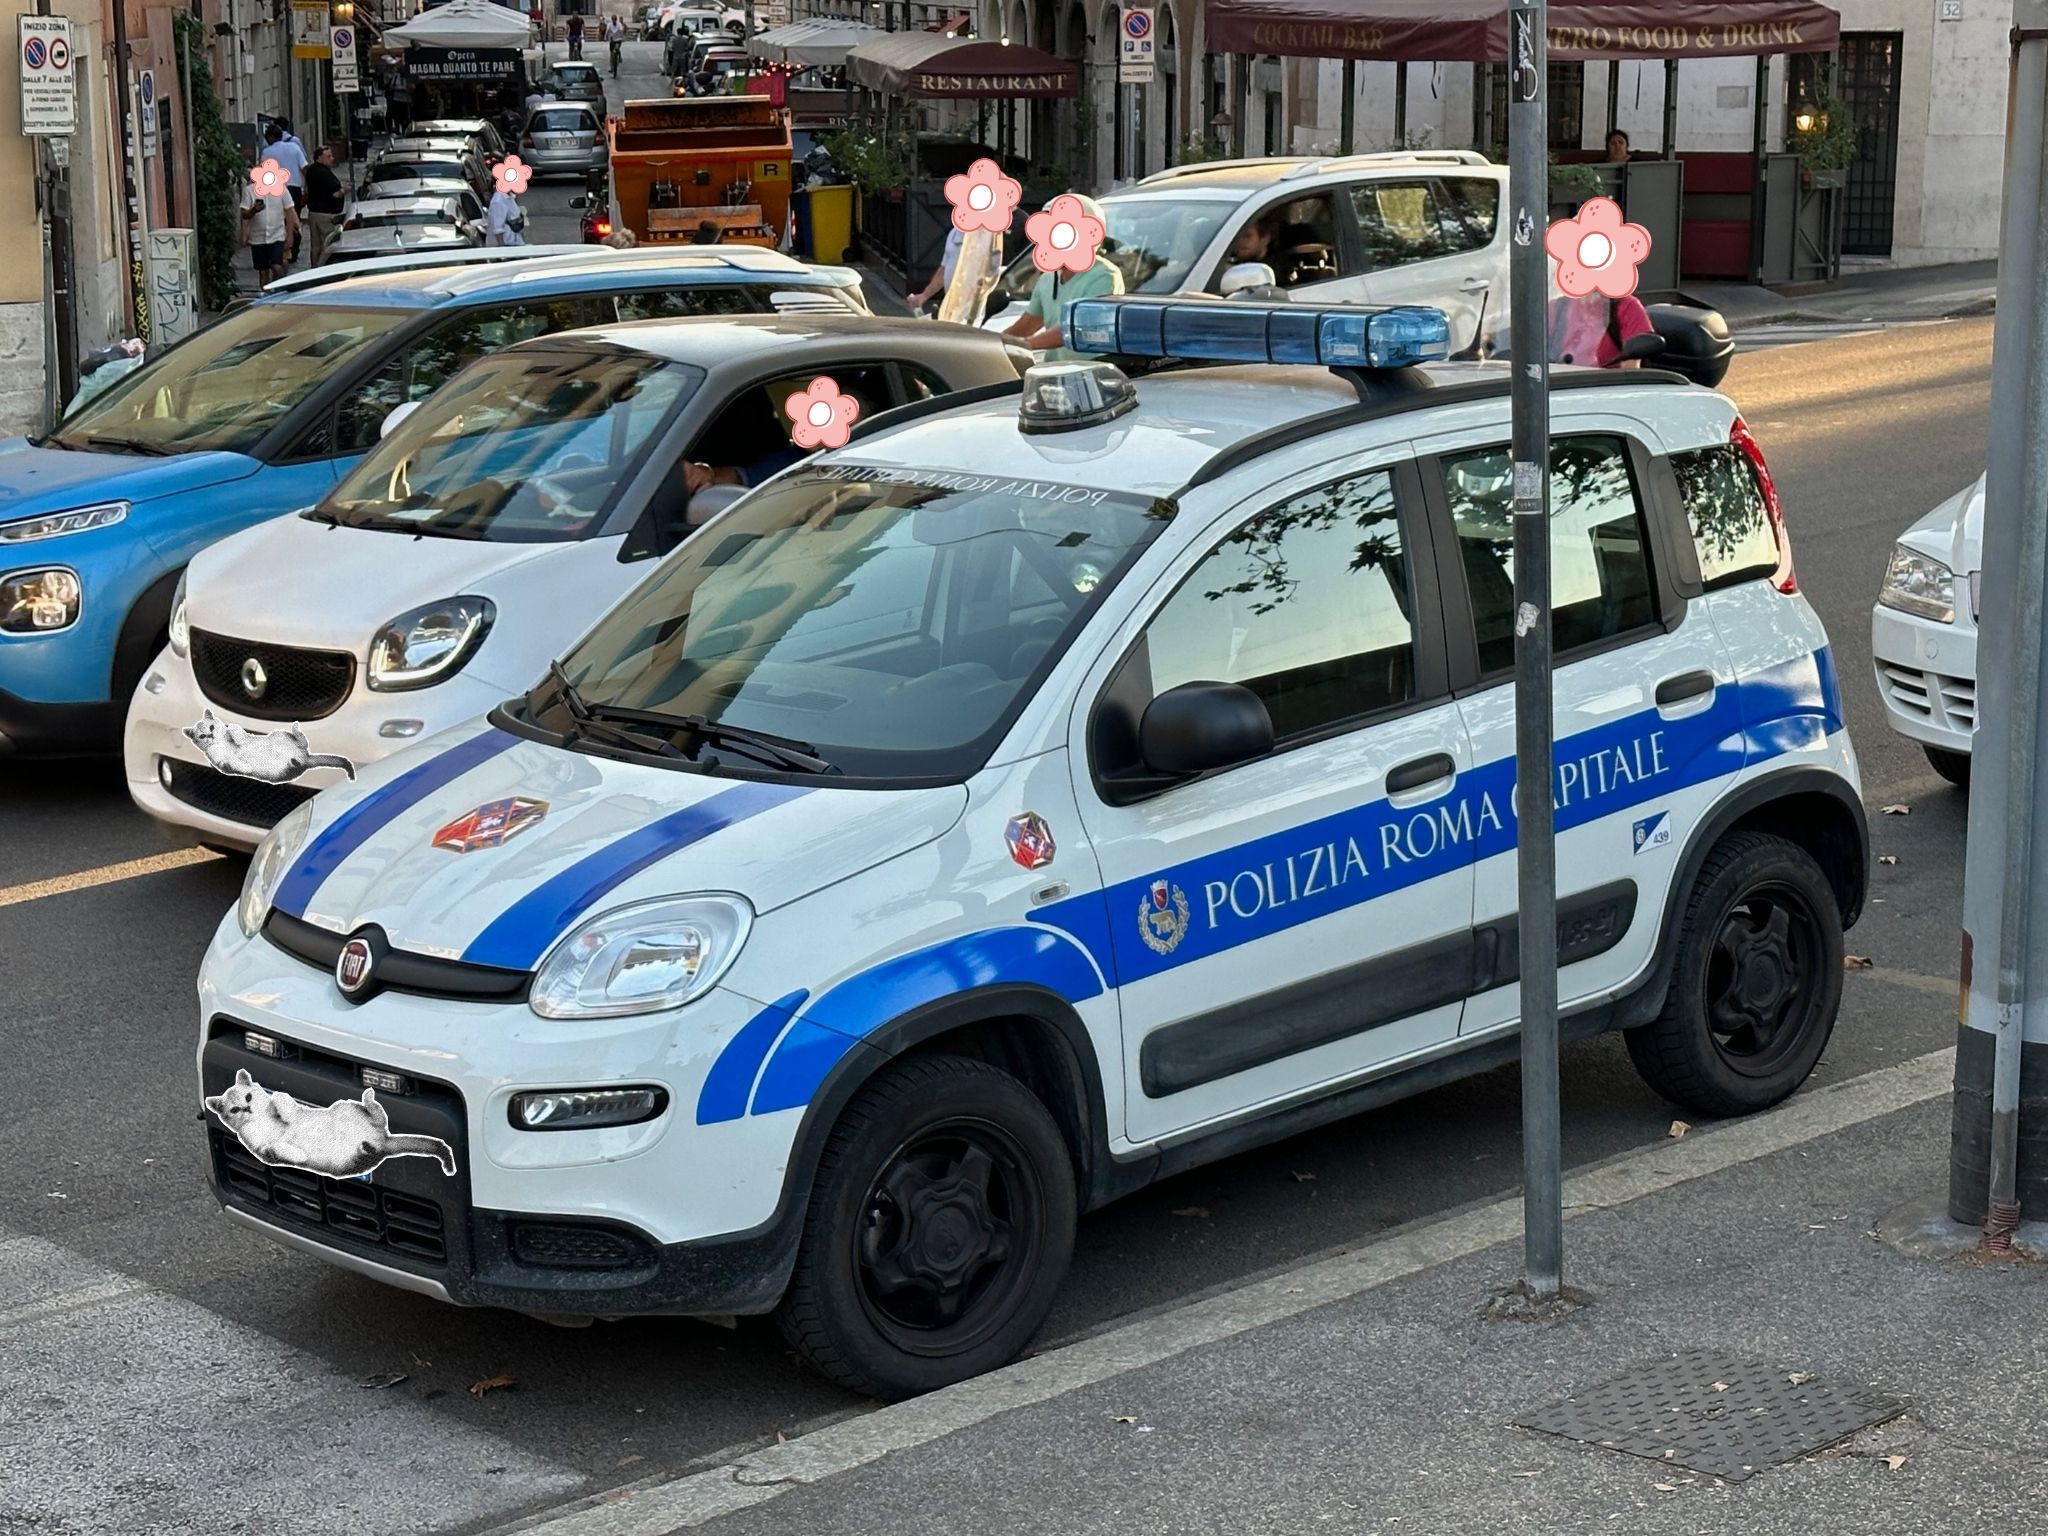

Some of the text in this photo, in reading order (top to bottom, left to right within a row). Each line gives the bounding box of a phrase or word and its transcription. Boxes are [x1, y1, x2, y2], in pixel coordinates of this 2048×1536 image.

[1945, 3, 1959, 16] 32
[48, 23, 66, 31] ZONA
[1254, 22, 1384, 50] COCKTAIL BAR
[1617, 26, 1688, 50] FOOD
[1696, 26, 1715, 49] &
[1723, 22, 1804, 48] DRINK
[409, 61, 516, 74] MAGNA QUANTO TE PARE
[42, 75, 47, 83] 7
[64, 75, 72, 83] 20
[921, 74, 1068, 91] RESTAURANT
[763, 163, 778, 176] R
[1204, 731, 1669, 929] POLIZIA ROMA PITALE
[344, 953, 365, 978] FIAT
